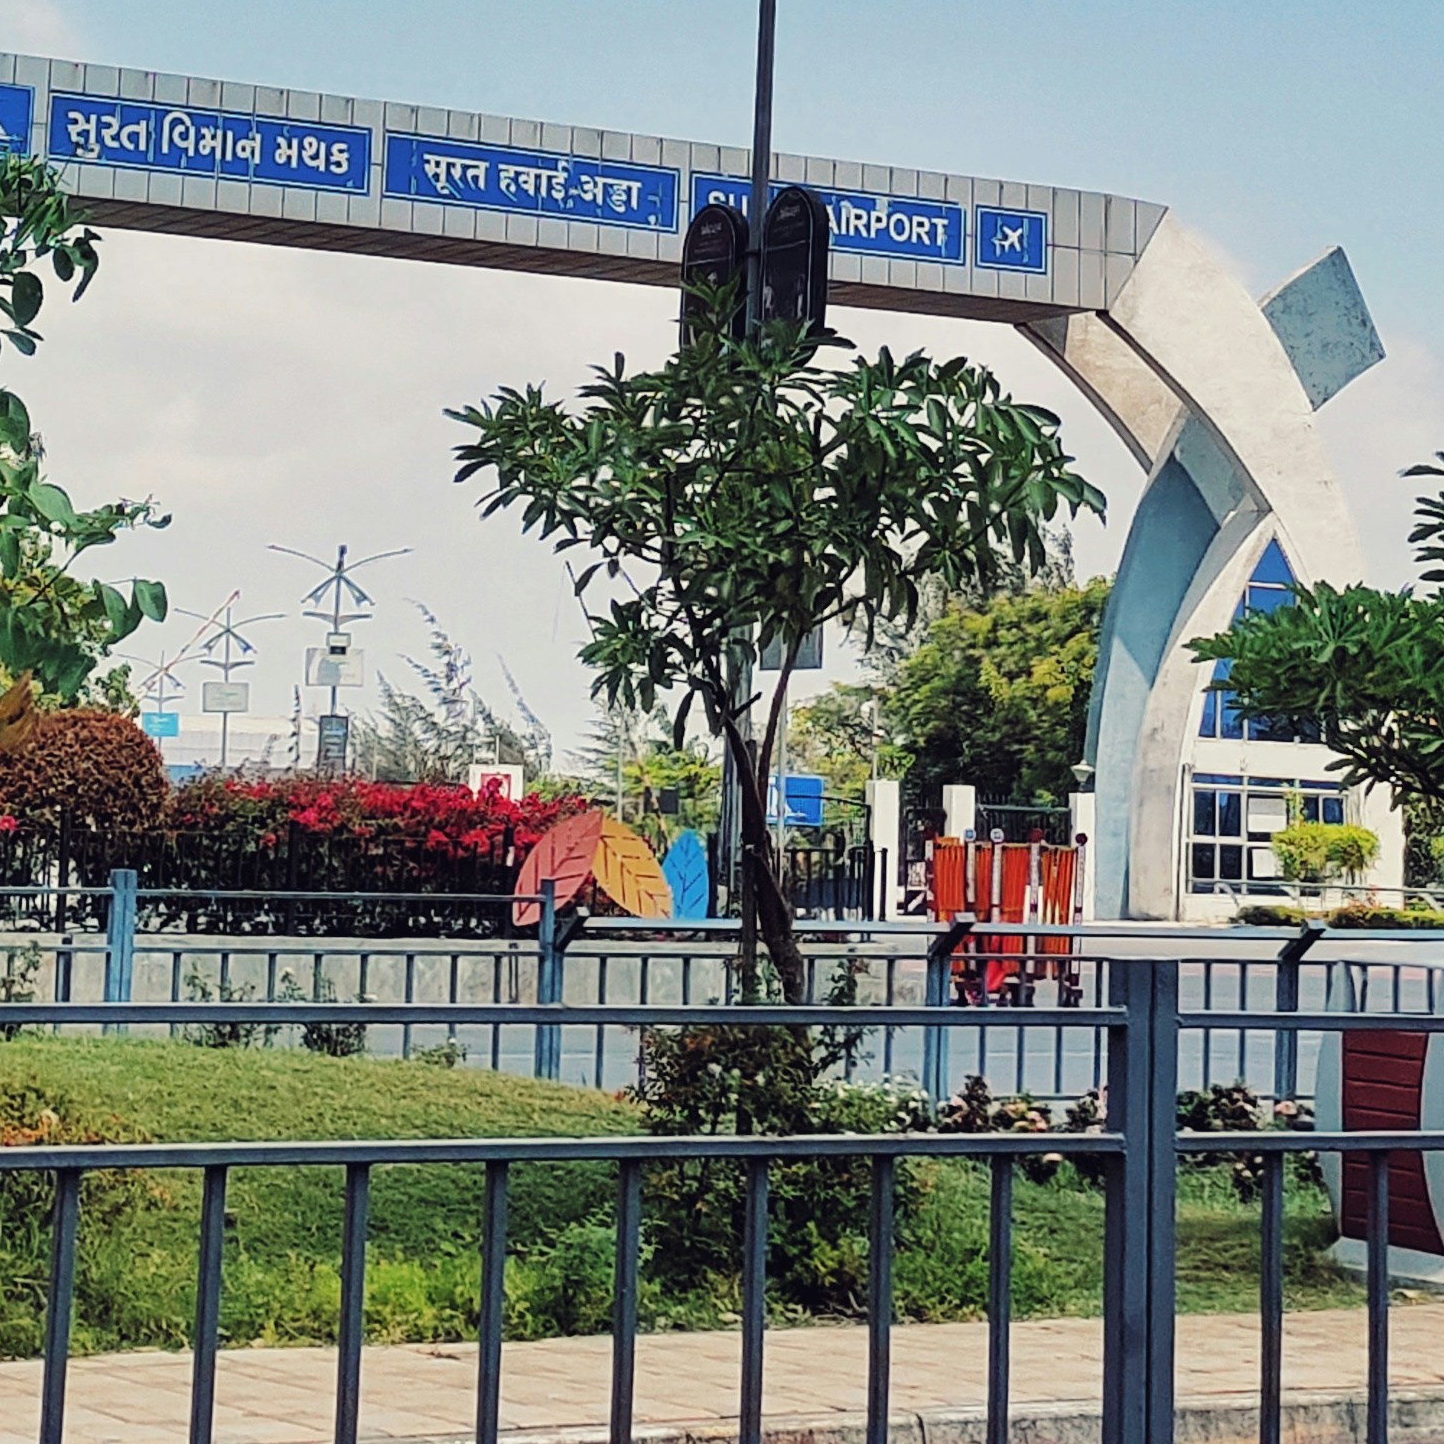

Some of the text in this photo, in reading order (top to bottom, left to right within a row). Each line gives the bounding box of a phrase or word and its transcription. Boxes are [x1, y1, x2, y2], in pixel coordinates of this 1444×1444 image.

[67, 111, 351, 176] સુરત વિમાન મથક
[423, 153, 489, 198] सूरत
